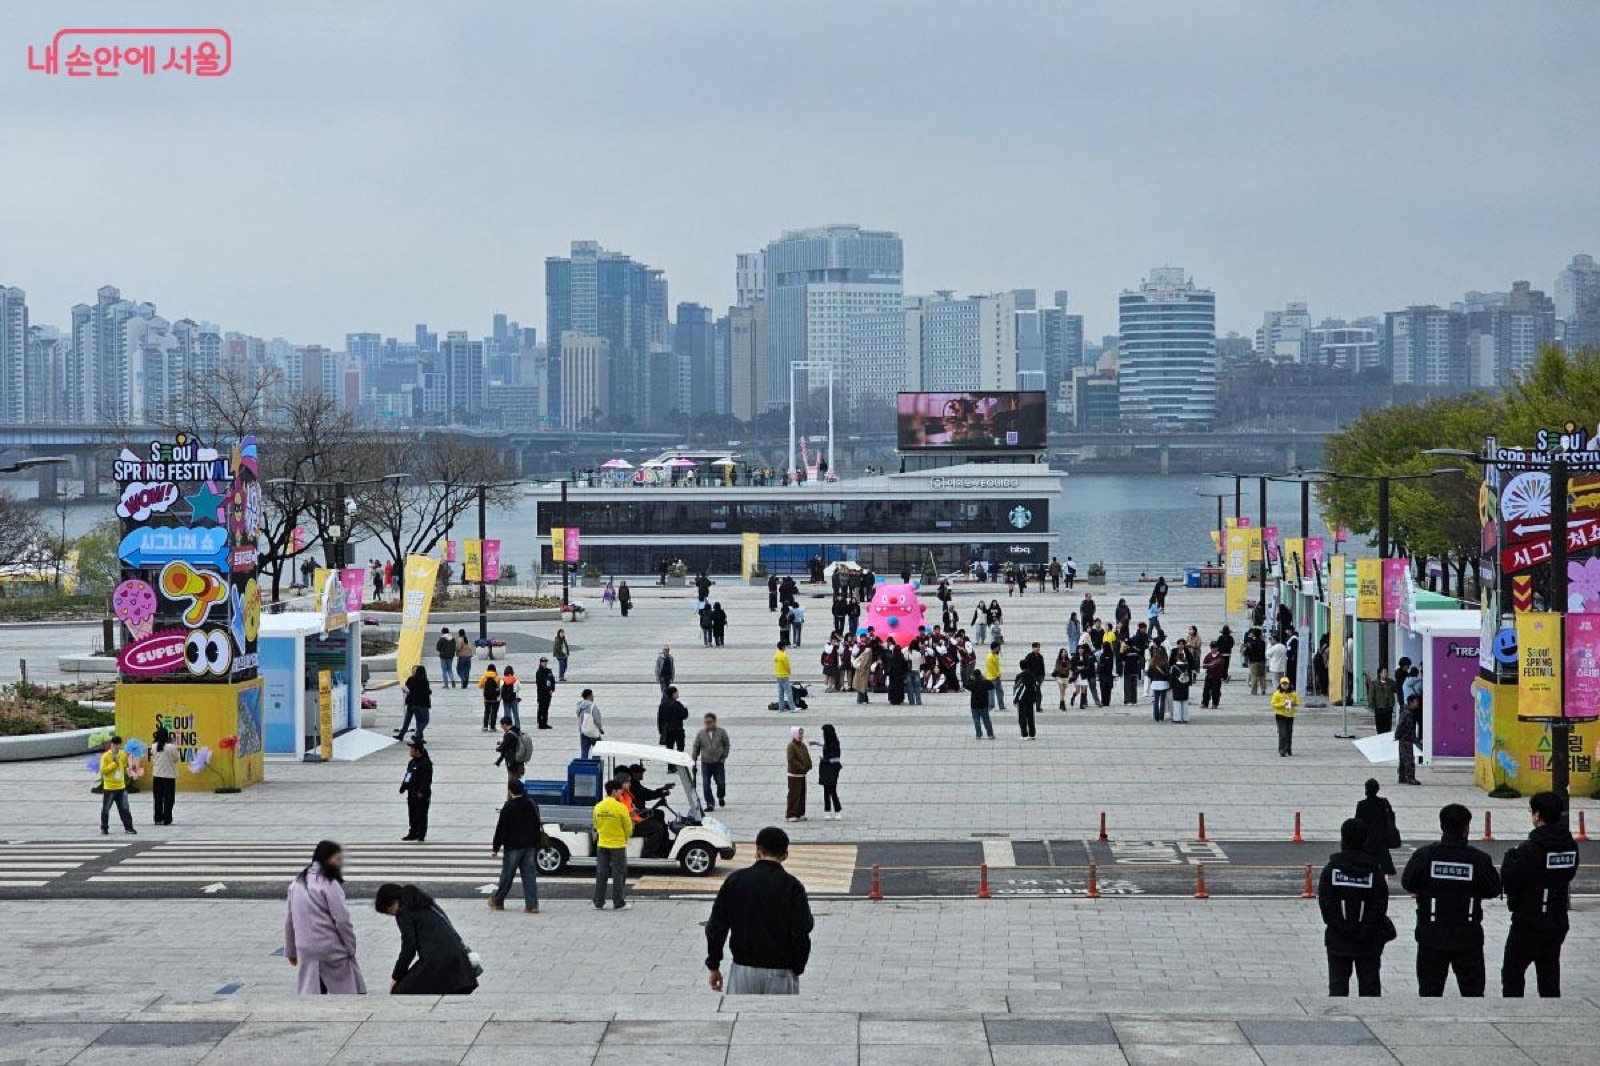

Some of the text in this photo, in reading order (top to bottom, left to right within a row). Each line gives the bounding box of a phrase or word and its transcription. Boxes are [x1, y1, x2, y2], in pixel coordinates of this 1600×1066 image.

[114, 460, 234, 481] SPRING FESTIVAL
[124, 484, 175, 514] WOW!
[140, 533, 214, 549] 시그니처 쇼
[1010, 546, 1030, 555] bbq
[1523, 667, 1555, 677] FESTIVAL
[1536, 734, 1583, 753] 스링
